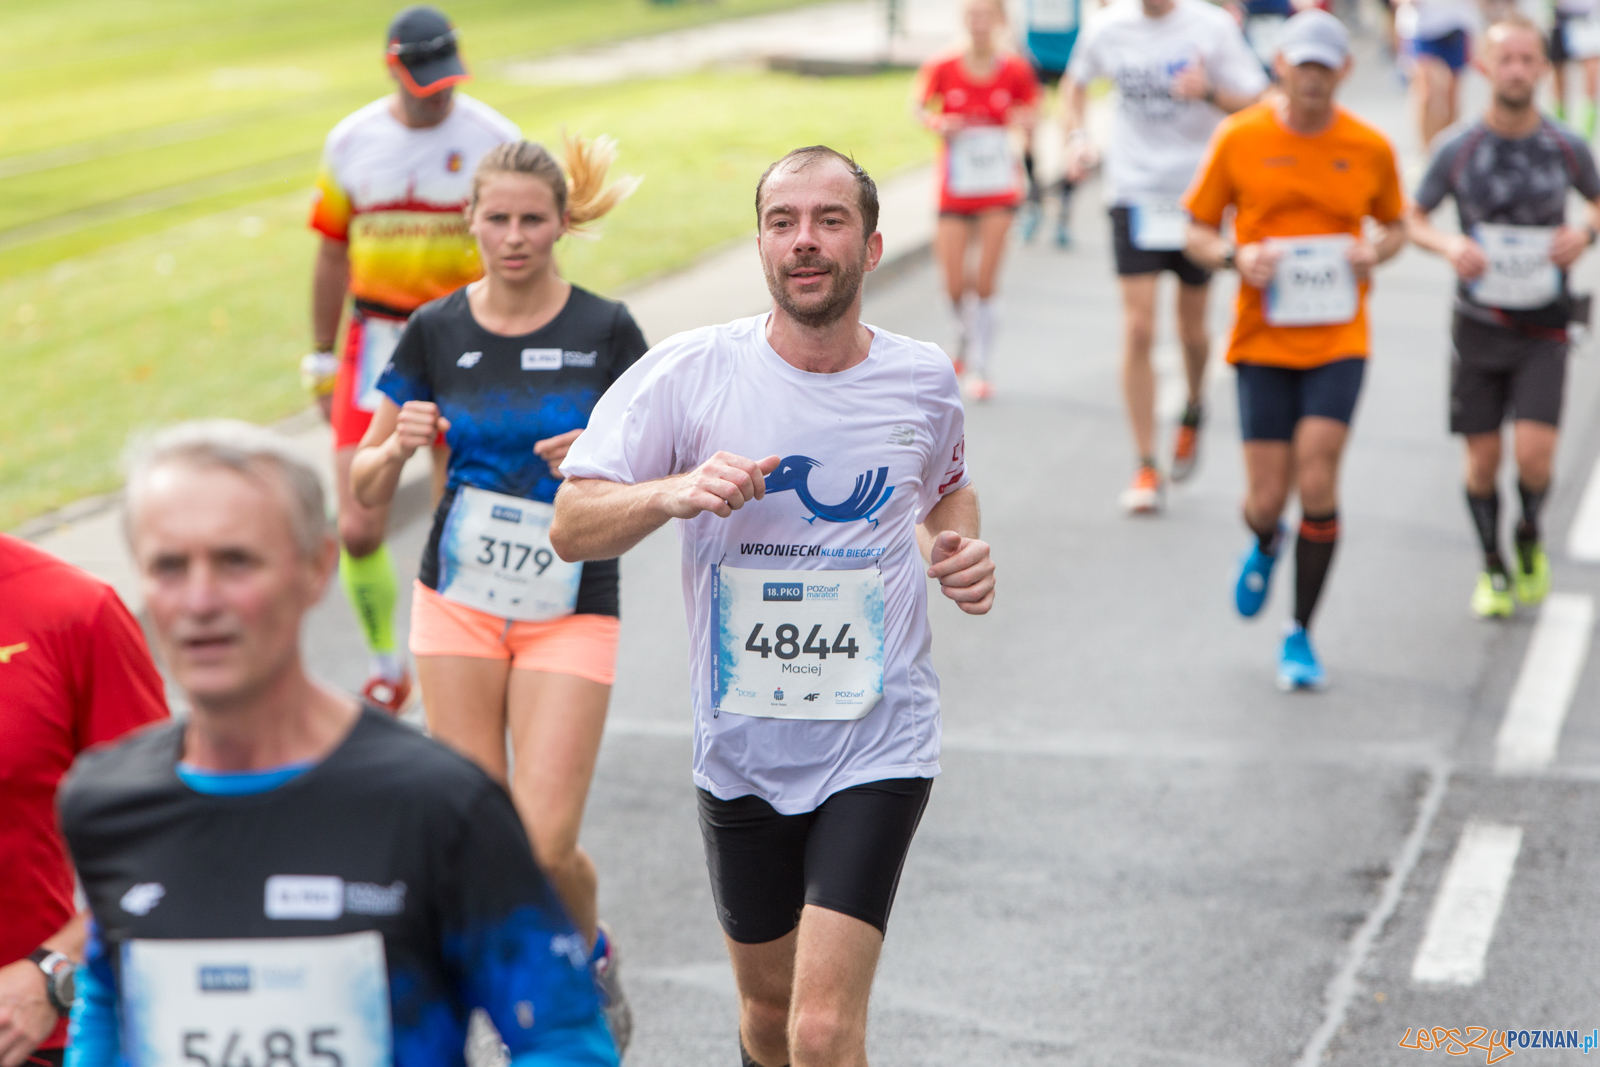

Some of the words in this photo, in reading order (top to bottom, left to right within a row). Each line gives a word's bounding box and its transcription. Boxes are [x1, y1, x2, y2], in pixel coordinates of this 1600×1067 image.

[476, 535, 554, 576] 3179
[740, 543, 821, 557] WRONIECKI
[820, 548, 844, 557] KLUB
[745, 622, 860, 660] 4844
[781, 663, 822, 676] Maciej
[181, 1028, 343, 1067] 5485
